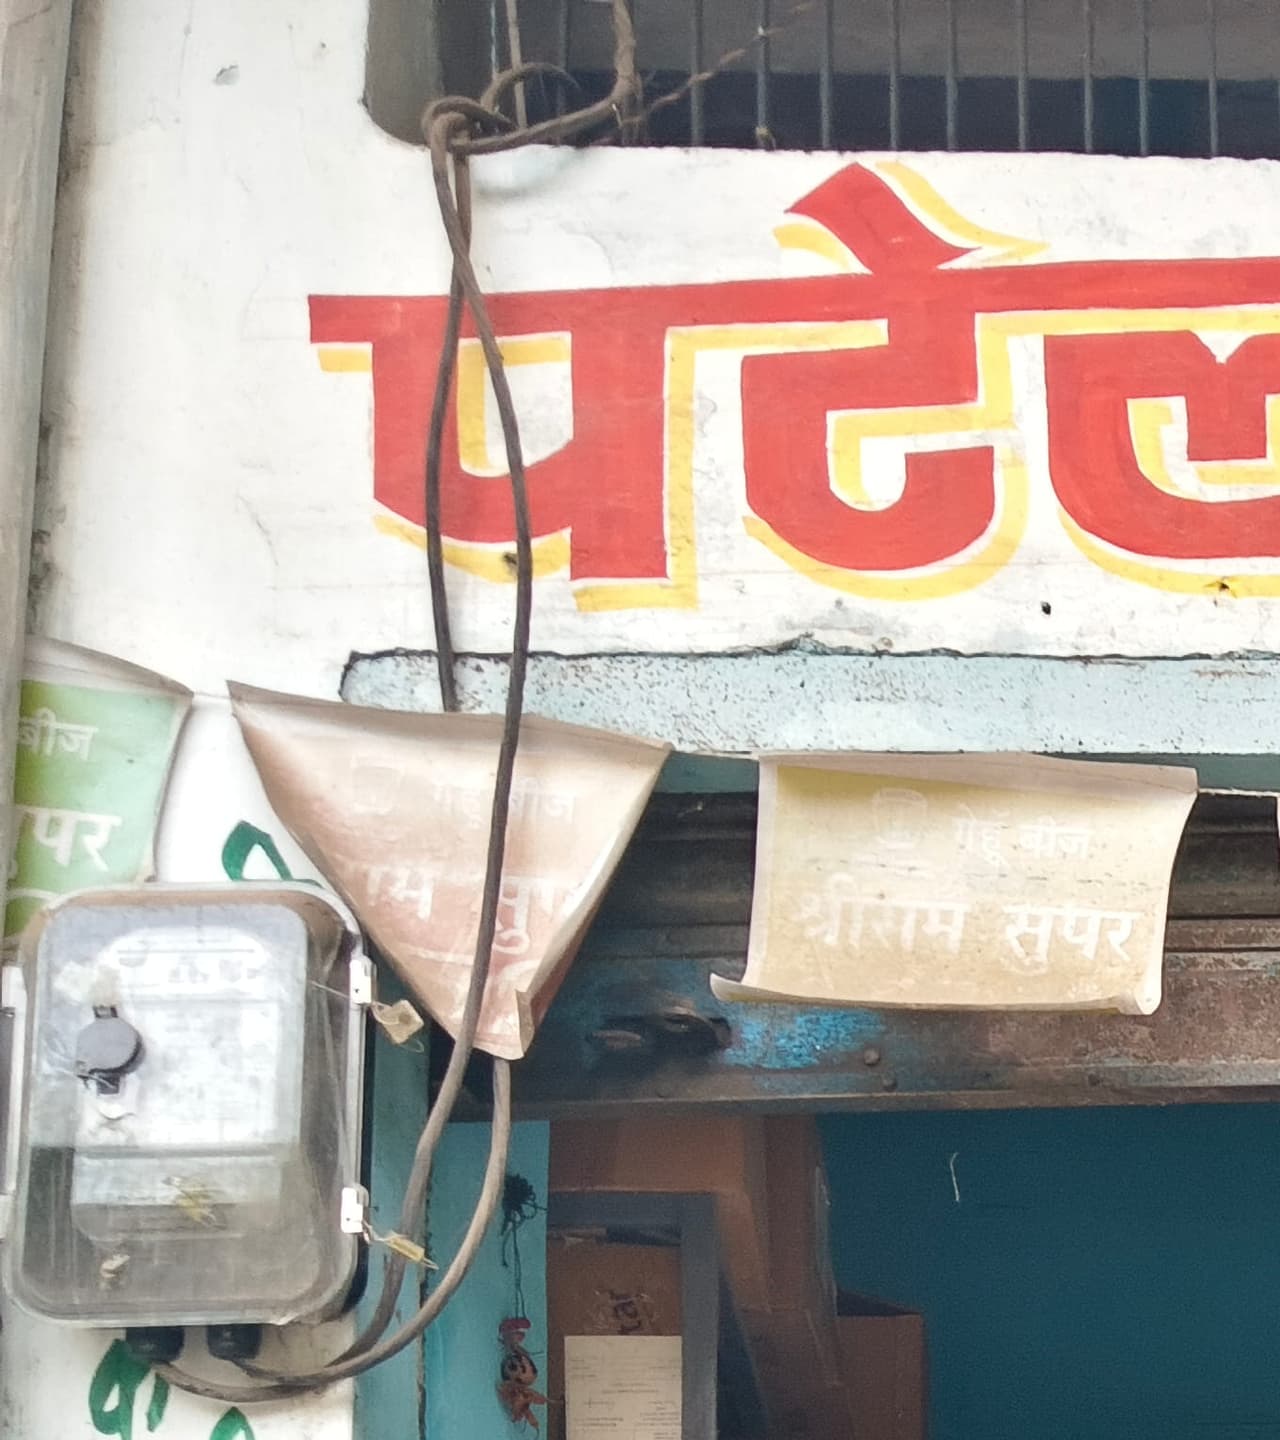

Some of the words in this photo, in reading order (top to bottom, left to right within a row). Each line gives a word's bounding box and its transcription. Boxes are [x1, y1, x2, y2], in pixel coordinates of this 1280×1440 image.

[1015, 815, 1093, 861] बीज
[794, 873, 973, 954] श्रीराम
[1002, 903, 1143, 977] सुपर
